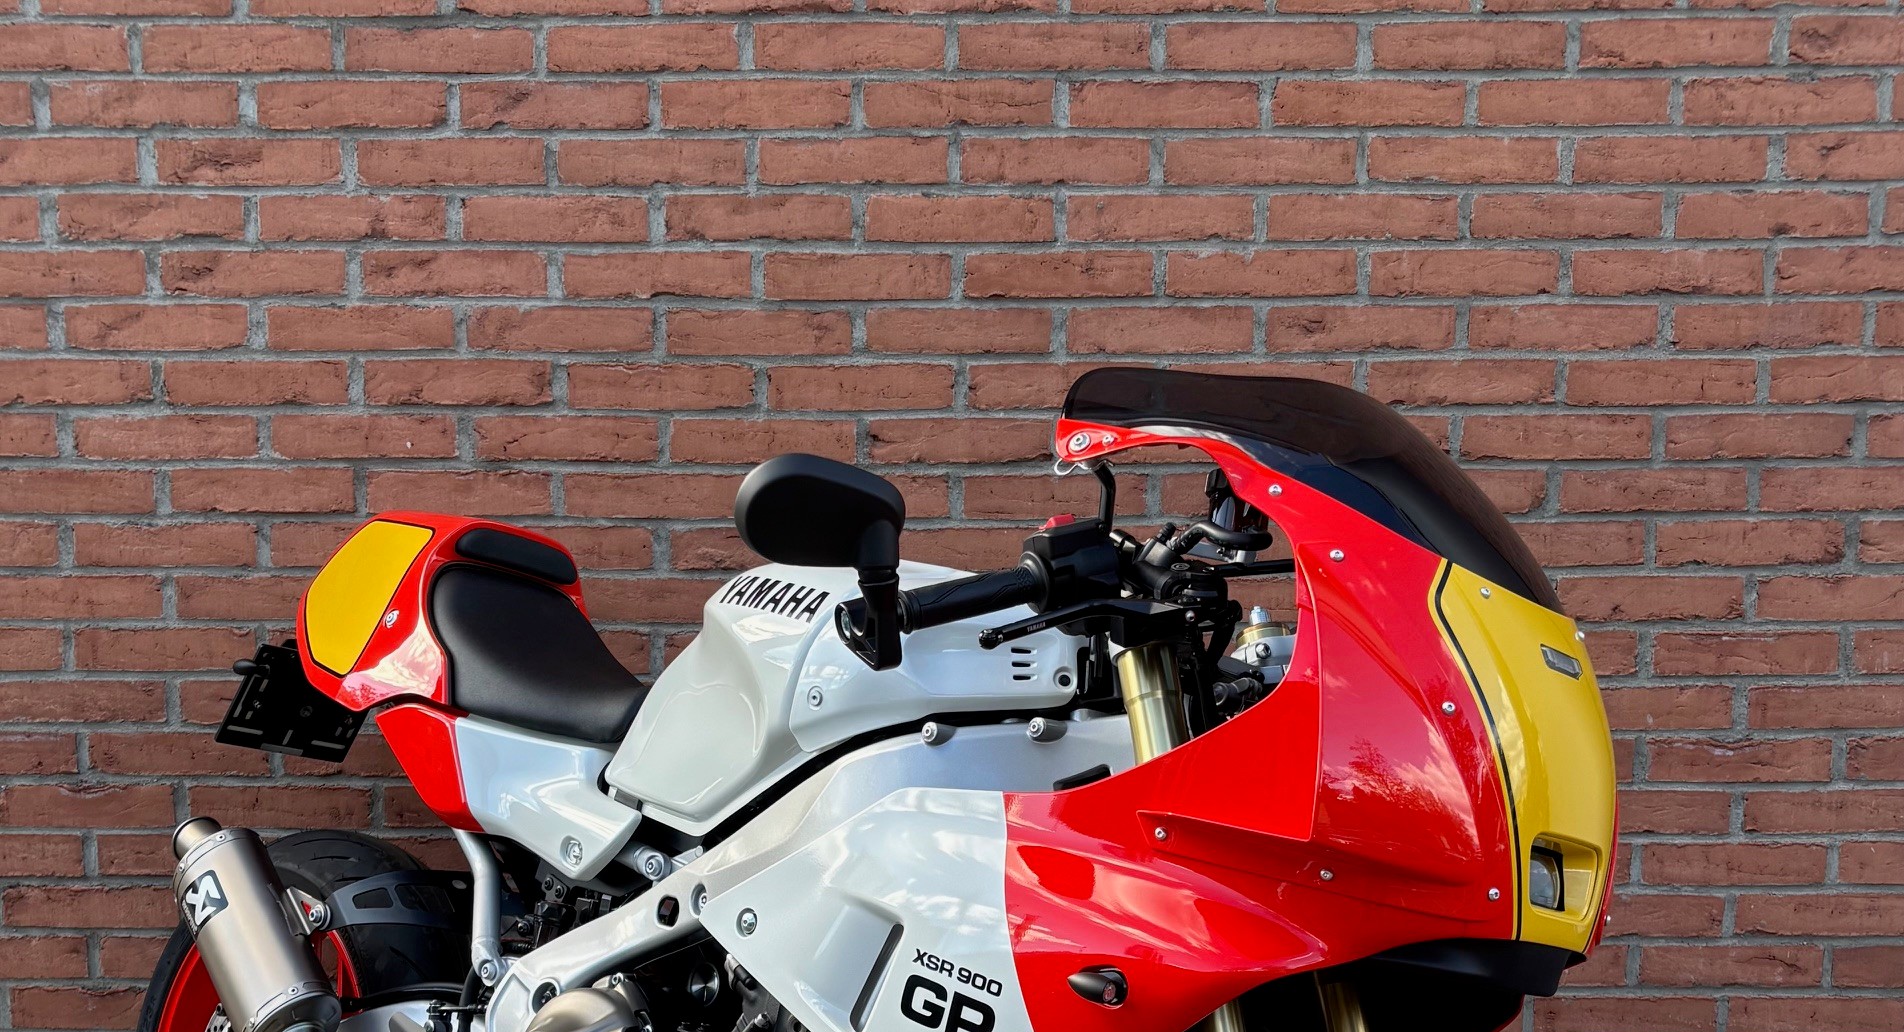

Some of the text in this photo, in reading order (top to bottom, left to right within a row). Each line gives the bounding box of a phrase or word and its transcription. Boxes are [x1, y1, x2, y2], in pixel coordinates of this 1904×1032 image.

[719, 575, 831, 624] YAMAHA
[912, 948, 1003, 998] XSR 900
